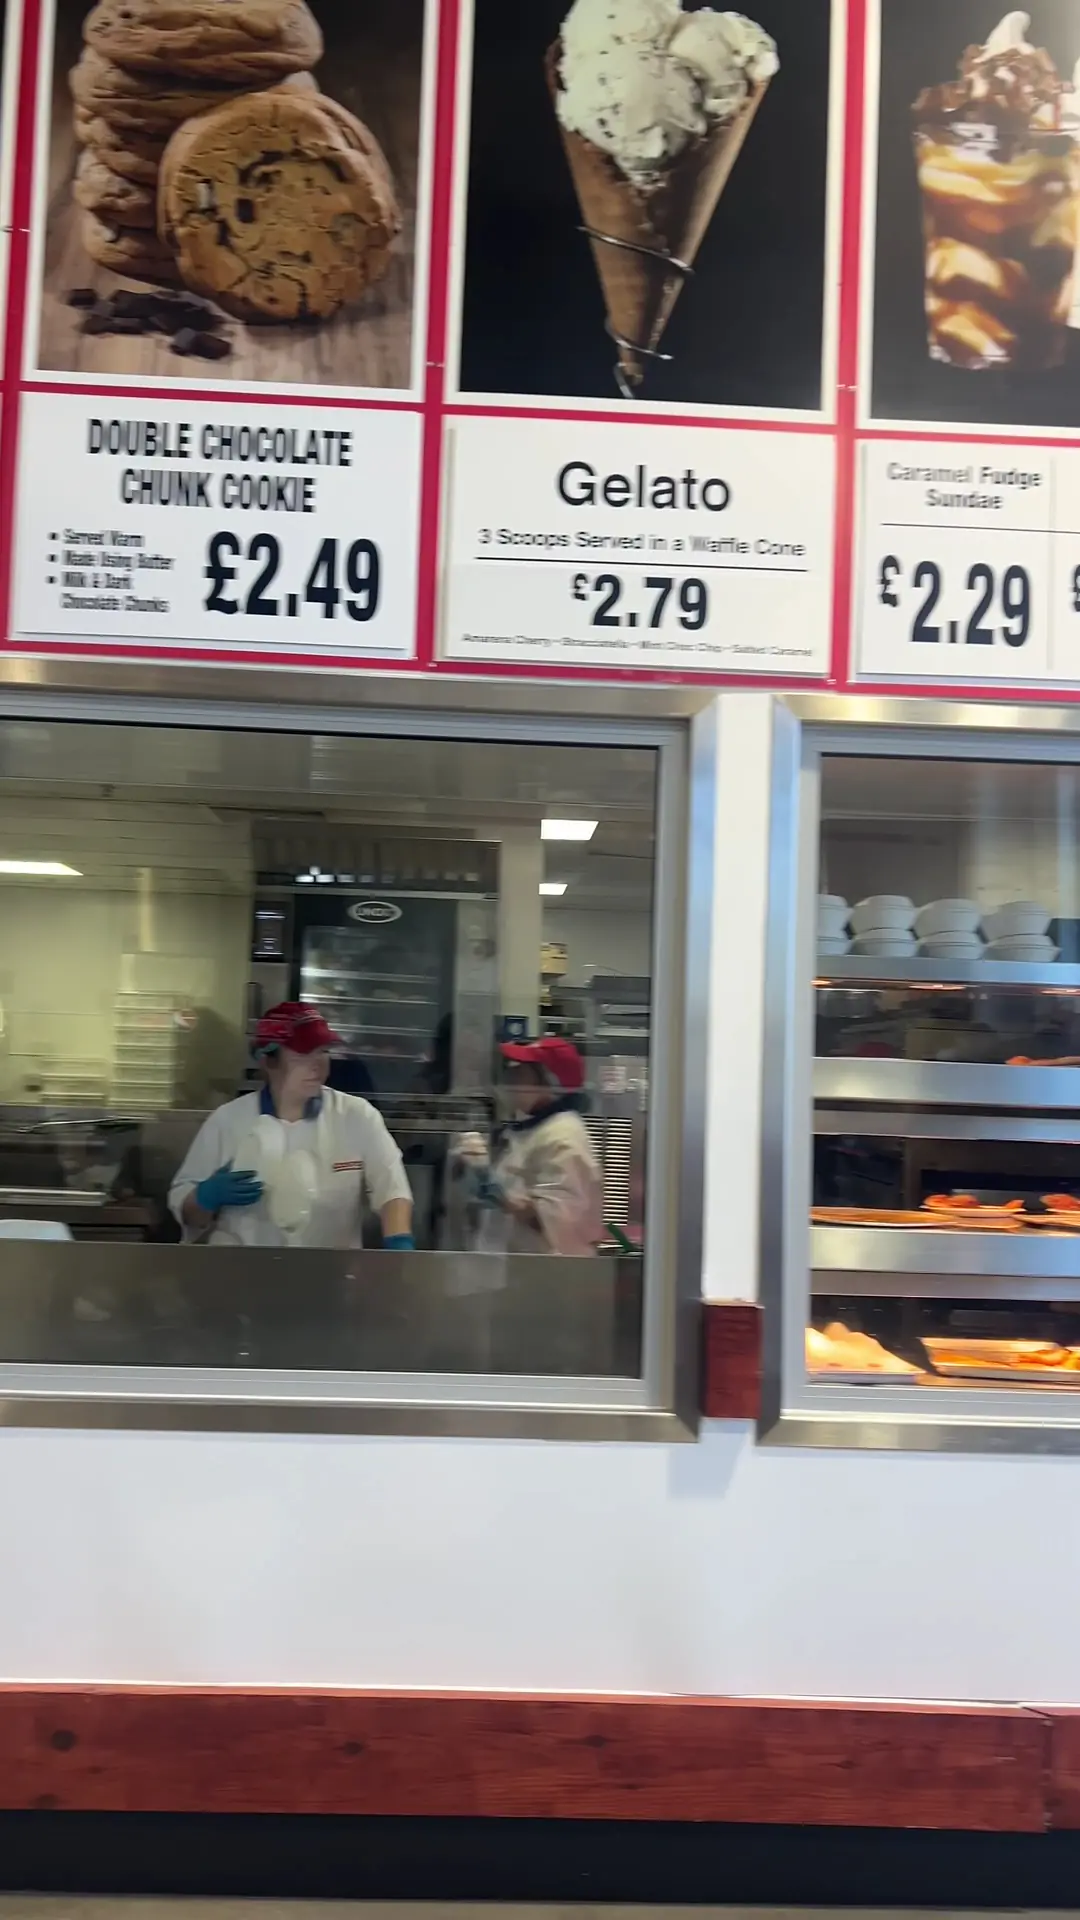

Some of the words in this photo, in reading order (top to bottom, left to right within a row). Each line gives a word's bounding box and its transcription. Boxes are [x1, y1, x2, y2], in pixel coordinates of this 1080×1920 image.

[87, 418, 191, 459] DOUBLE
[201, 423, 352, 467] CHOCOLATE
[121, 468, 212, 508] CHUNK
[221, 473, 316, 513] COOKIE
[557, 461, 731, 512] Gelato
[887, 462, 973, 484] Caramel
[979, 466, 1043, 490] Fudge
[925, 488, 1003, 510] Sundae
[477, 528, 493, 545] 3
[497, 528, 571, 549] Scoops
[574, 531, 645, 549] Served
[648, 533, 668, 551] in
[672, 538, 684, 551] a
[689, 534, 750, 554] Waffle
[754, 538, 806, 556] Cone
[204, 531, 382, 622] £2.49
[571, 572, 709, 631] £2.79
[879, 555, 1032, 648] £2.29
